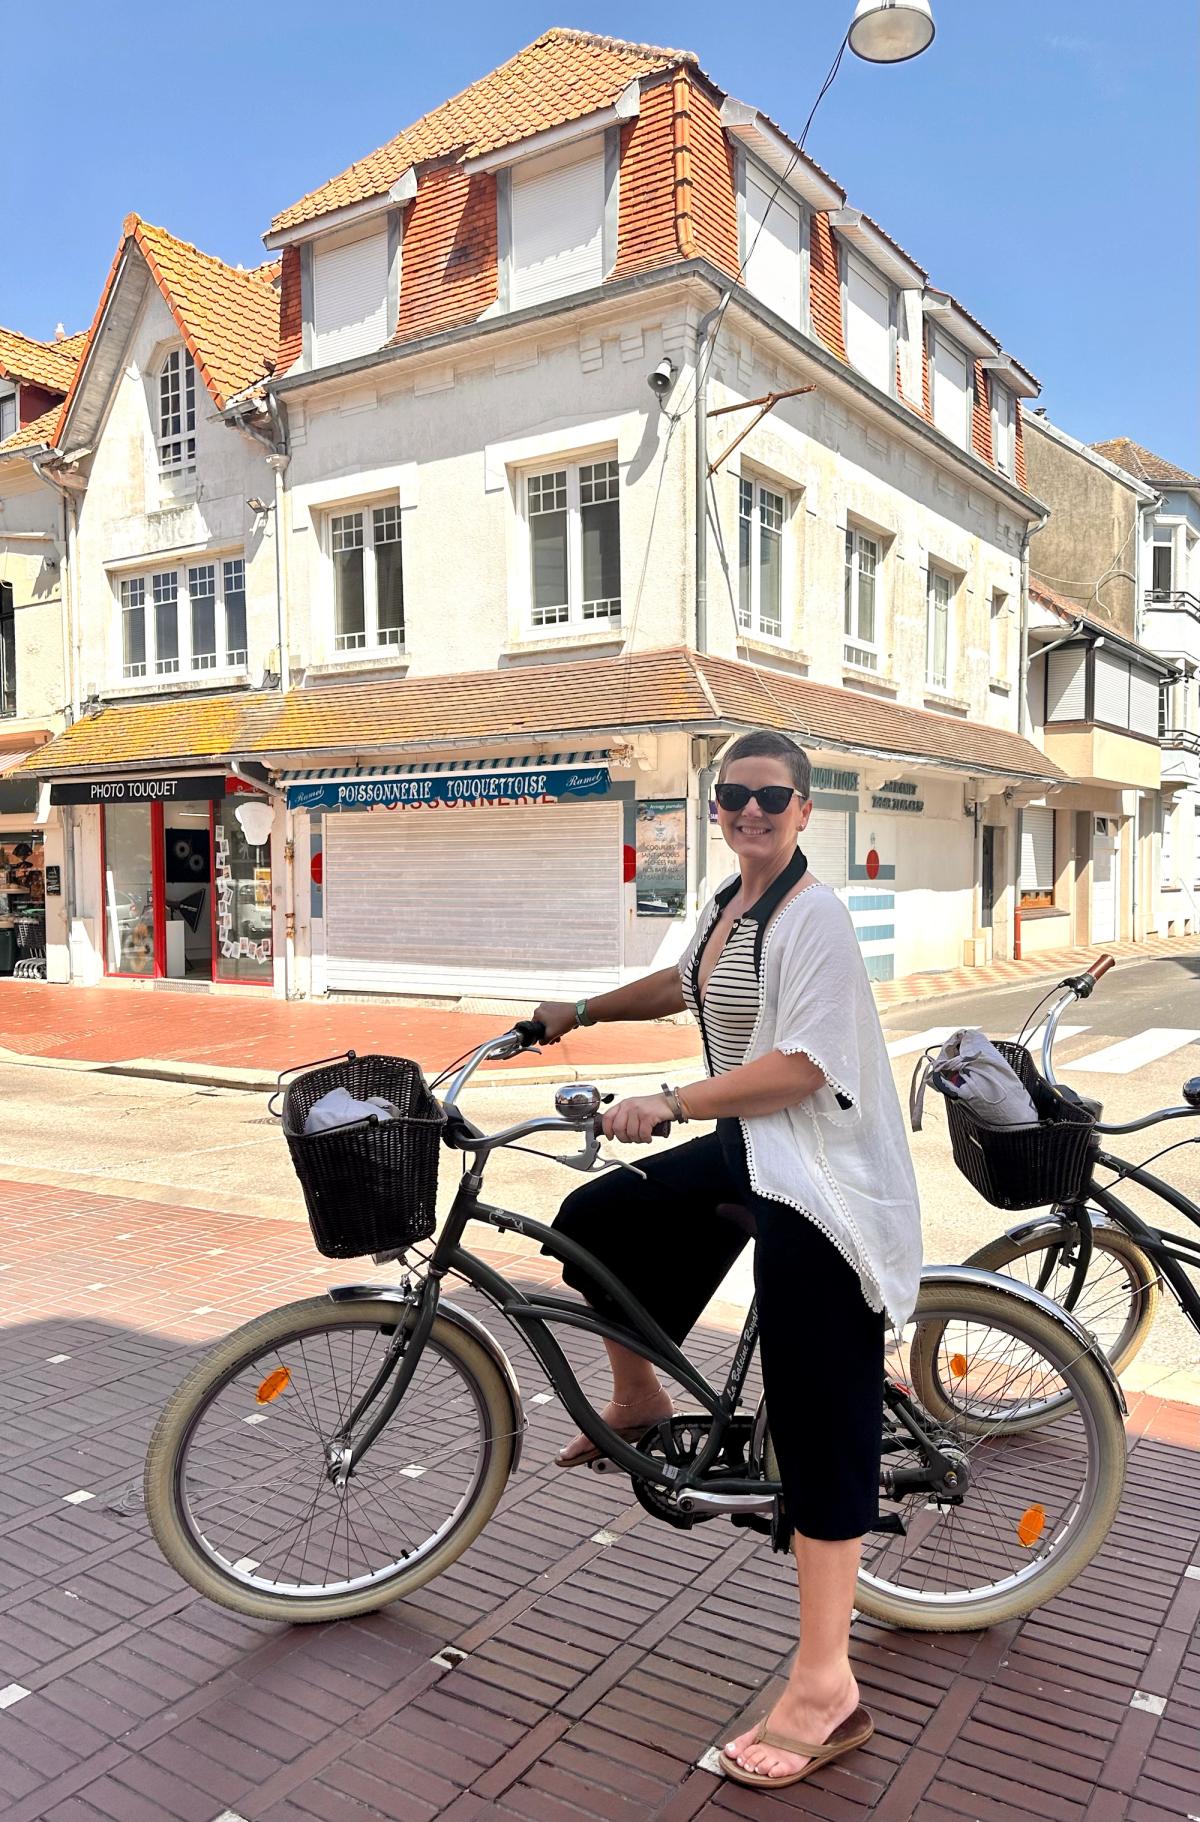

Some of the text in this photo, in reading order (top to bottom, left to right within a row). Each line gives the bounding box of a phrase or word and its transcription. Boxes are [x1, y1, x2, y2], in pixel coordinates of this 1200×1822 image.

[90, 780, 178, 799] PHOTO TOUQUET
[338, 775, 547, 803] POISSONNERIE TOUQUETTOISE
[566, 771, 603, 791] Ramel
[731, 1344, 749, 1382] Baleine
[726, 1387, 737, 1402] La
